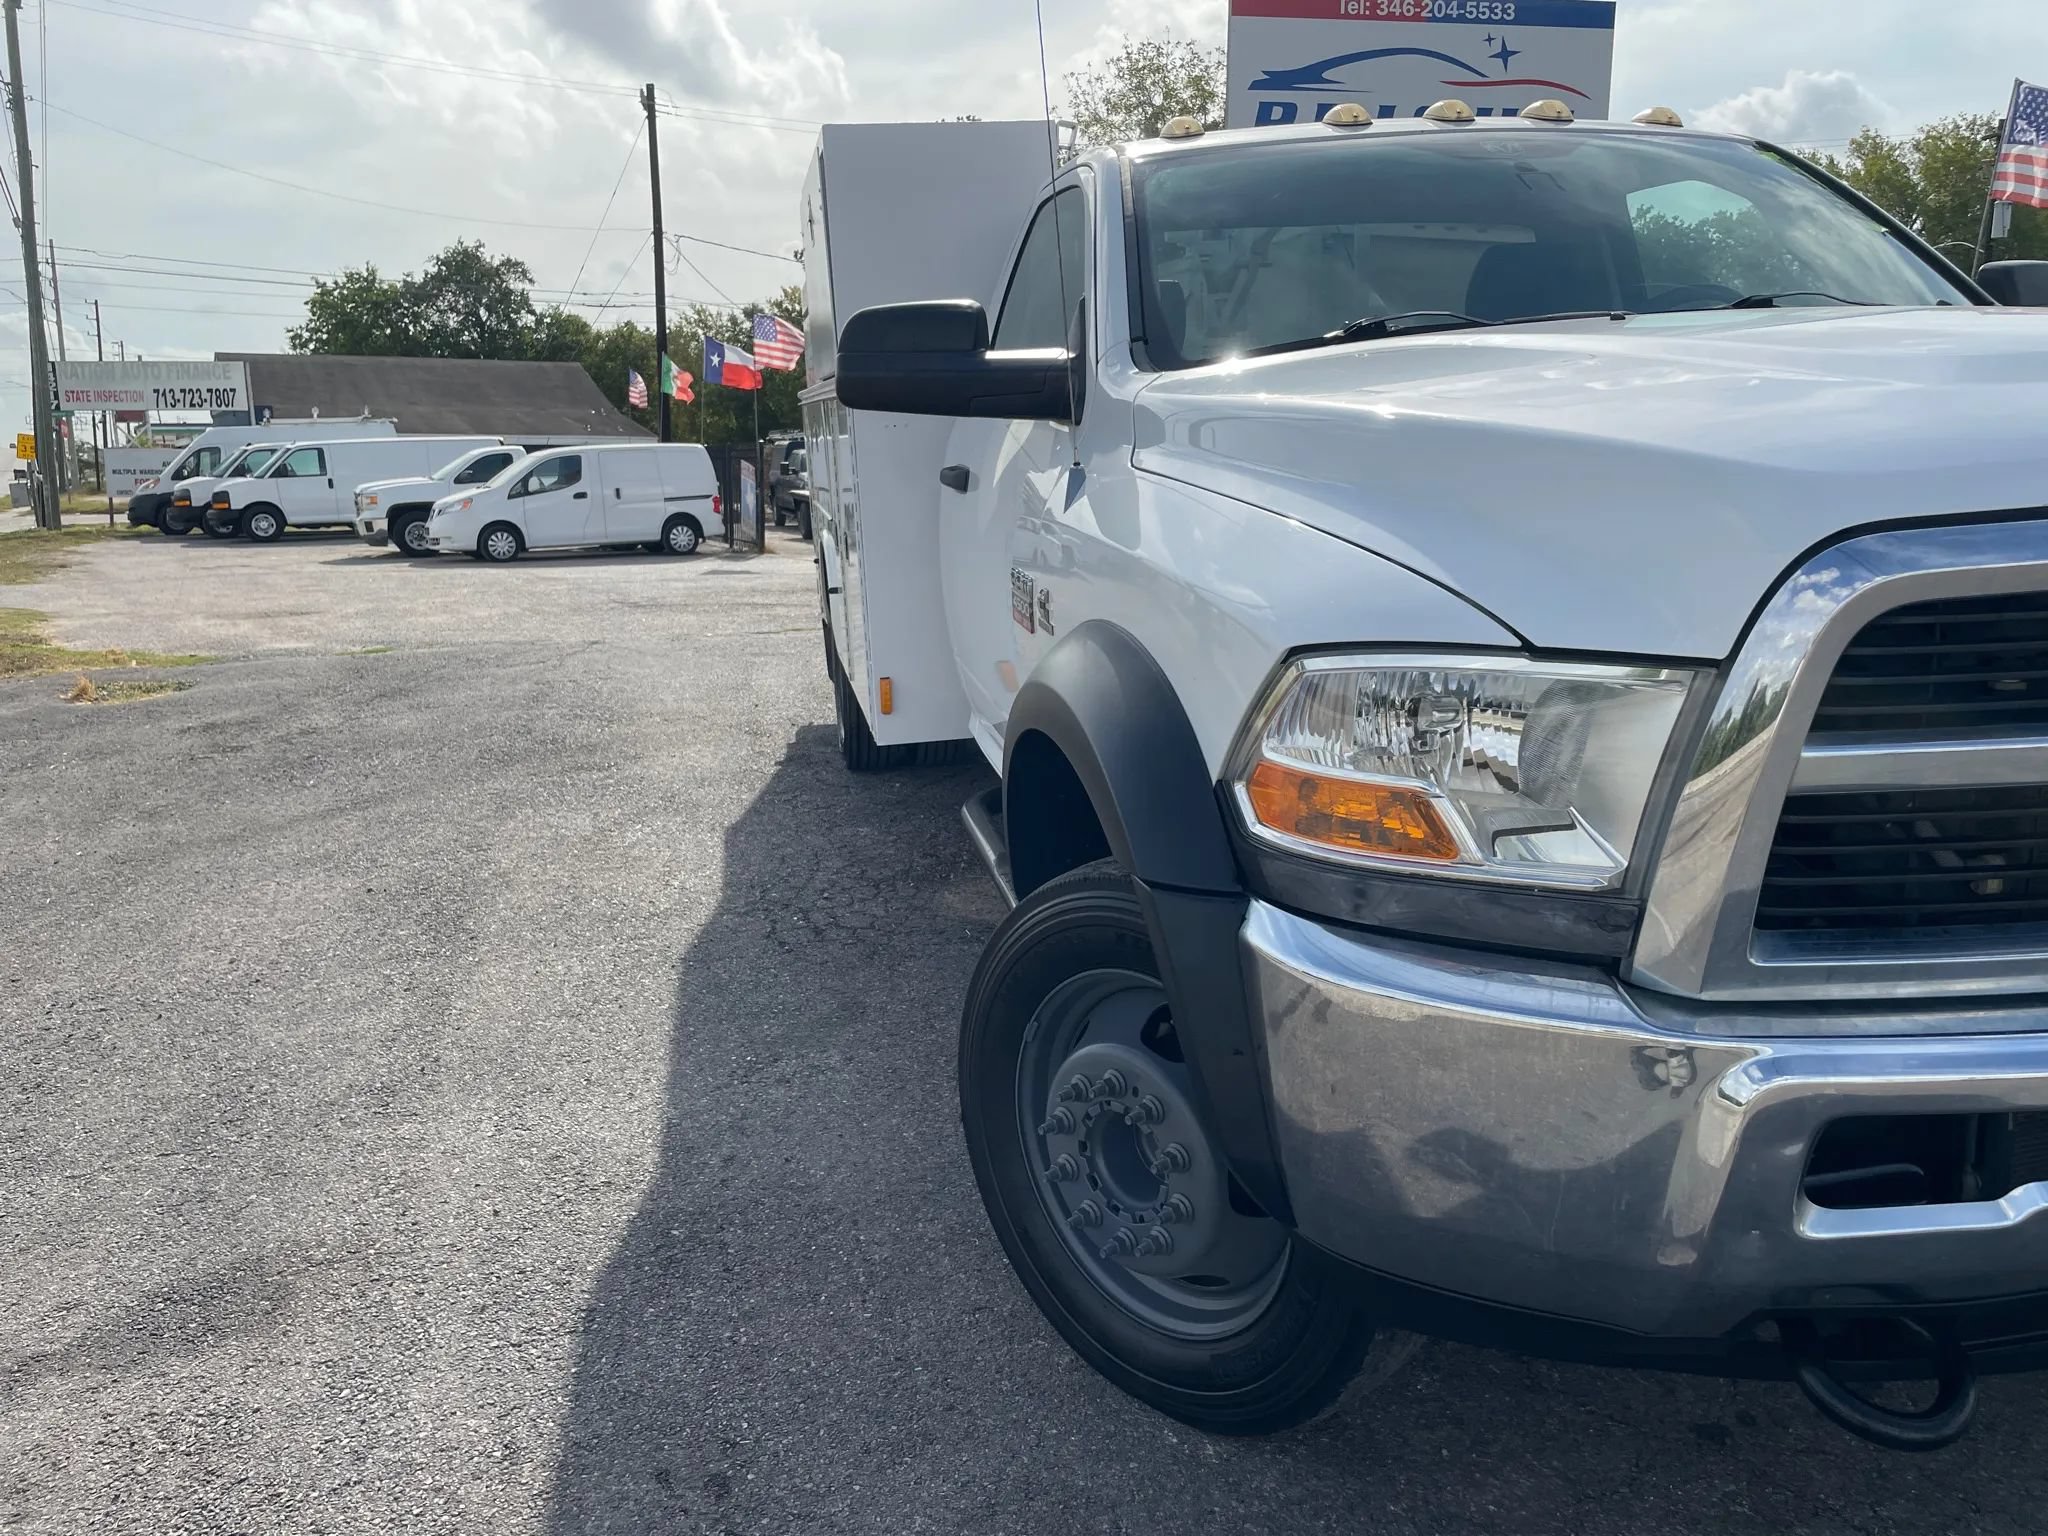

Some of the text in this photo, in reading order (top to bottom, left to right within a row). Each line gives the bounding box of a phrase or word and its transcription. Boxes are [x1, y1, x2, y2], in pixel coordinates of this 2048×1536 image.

[1340, 0, 1516, 20] Tel: 346-204-5533
[166, 362, 233, 380] FINANCE
[64, 389, 144, 403] STATE INSPECTION
[153, 388, 236, 408] 713-723-7807
